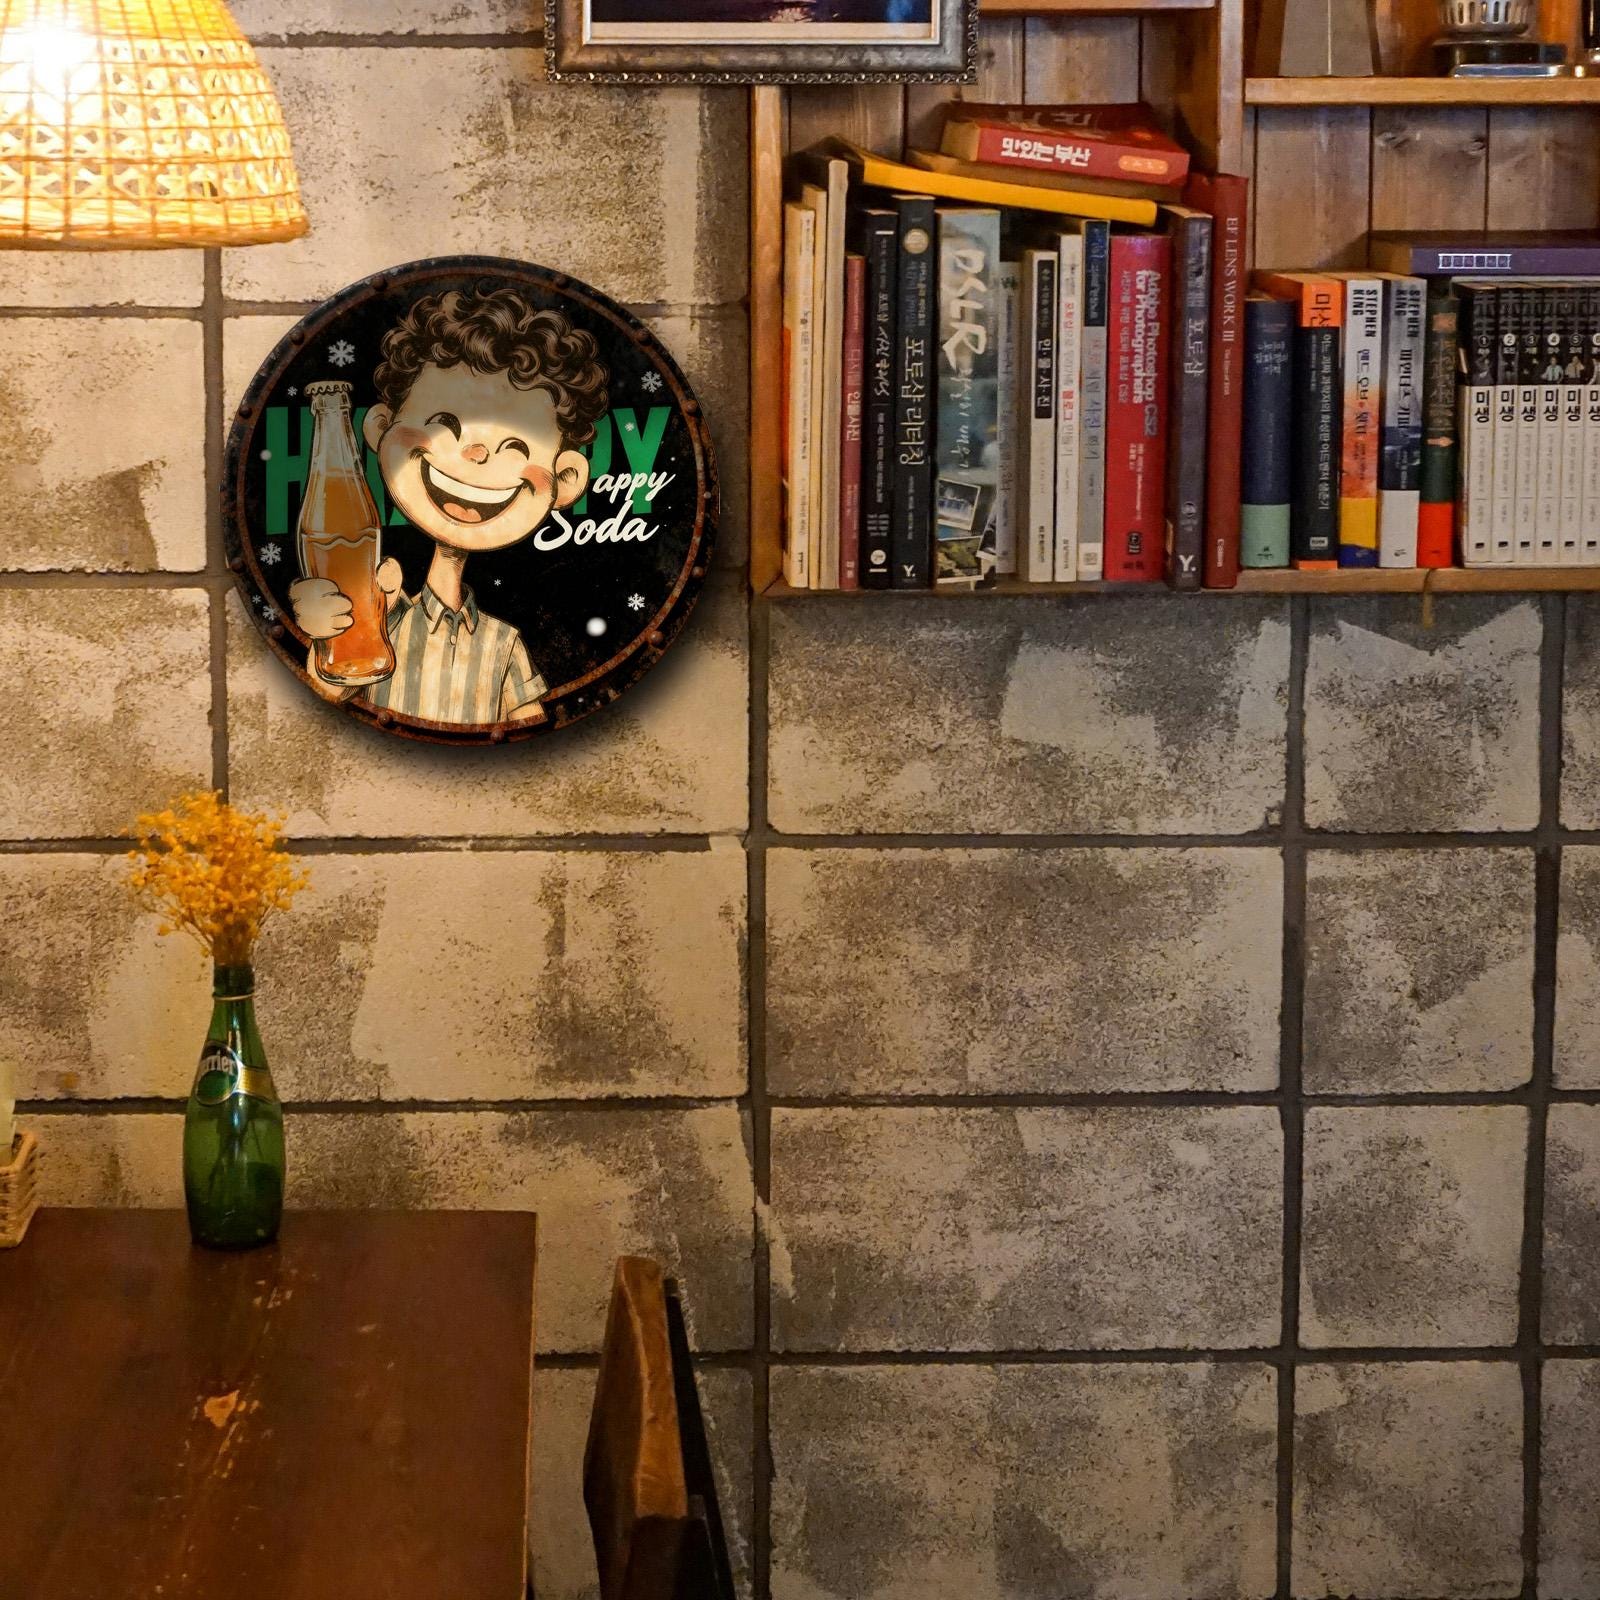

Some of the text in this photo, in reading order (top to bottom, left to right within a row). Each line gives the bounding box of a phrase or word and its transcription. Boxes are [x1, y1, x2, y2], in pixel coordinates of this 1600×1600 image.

[1226, 216, 1238, 235] EF
[1225, 238, 1238, 277] LENS
[942, 248, 988, 371] DSLR
[1223, 280, 1236, 326] WORK
[1352, 289, 1365, 316] KING
[1364, 289, 1378, 338] STEPHEN
[1394, 289, 1408, 317] KING
[1407, 289, 1421, 338] STEPHEN
[1131, 269, 1149, 404] for Photographers
[1143, 270, 1161, 437] Adobe Photoshop CS2
[1183, 317, 1206, 377] 포토샵
[1399, 348, 1413, 400] 파인더스
[846, 390, 861, 442] 인물사진
[900, 335, 927, 466] 포토샵 리터칭
[1474, 390, 1490, 423] 미생
[1499, 389, 1515, 423] 미생
[1521, 389, 1537, 422] 미생
[1543, 389, 1559, 422] 미생
[1565, 389, 1581, 422] 미생
[533, 500, 660, 552] Soda
